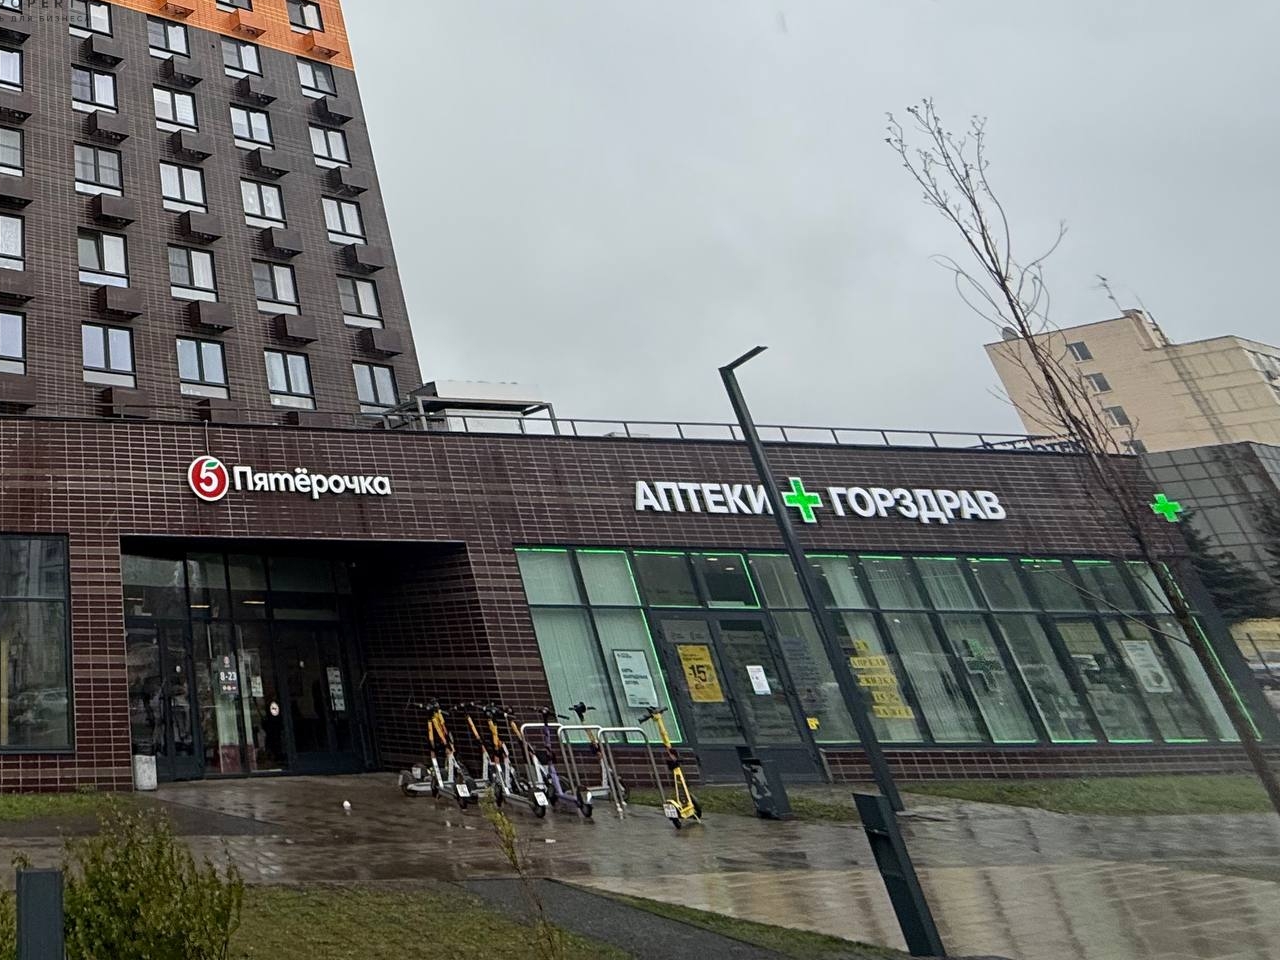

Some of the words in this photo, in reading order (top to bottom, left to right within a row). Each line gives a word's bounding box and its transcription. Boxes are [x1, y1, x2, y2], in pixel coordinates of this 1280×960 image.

[232, 466, 392, 500] Пятёрочка
[635, 480, 774, 515] АПТЕКИ
[827, 486, 1008, 525] ГОРЗДРАВ
